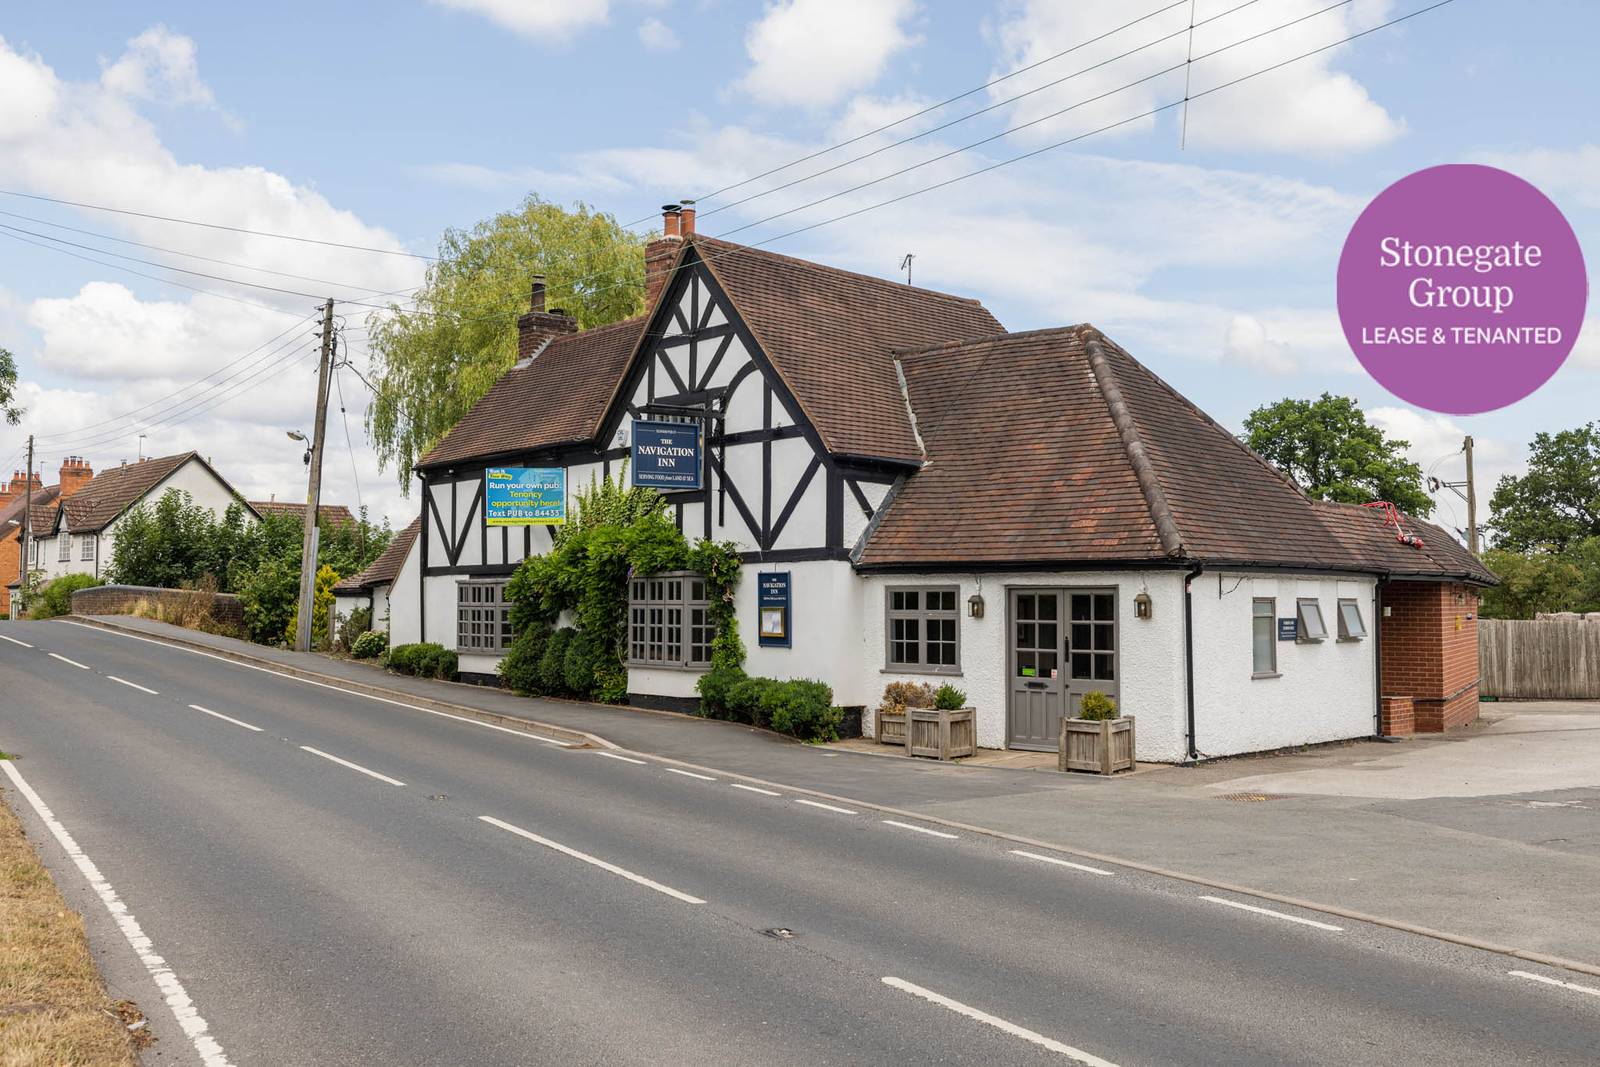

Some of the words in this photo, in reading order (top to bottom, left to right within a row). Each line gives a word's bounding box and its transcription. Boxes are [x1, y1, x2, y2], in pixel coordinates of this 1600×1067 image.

[638, 445, 695, 457] NAVIGATION
[657, 457, 676, 467] INN
[491, 500, 539, 508] opportunity
[488, 509, 506, 517] Text
[507, 509, 524, 517] PUB
